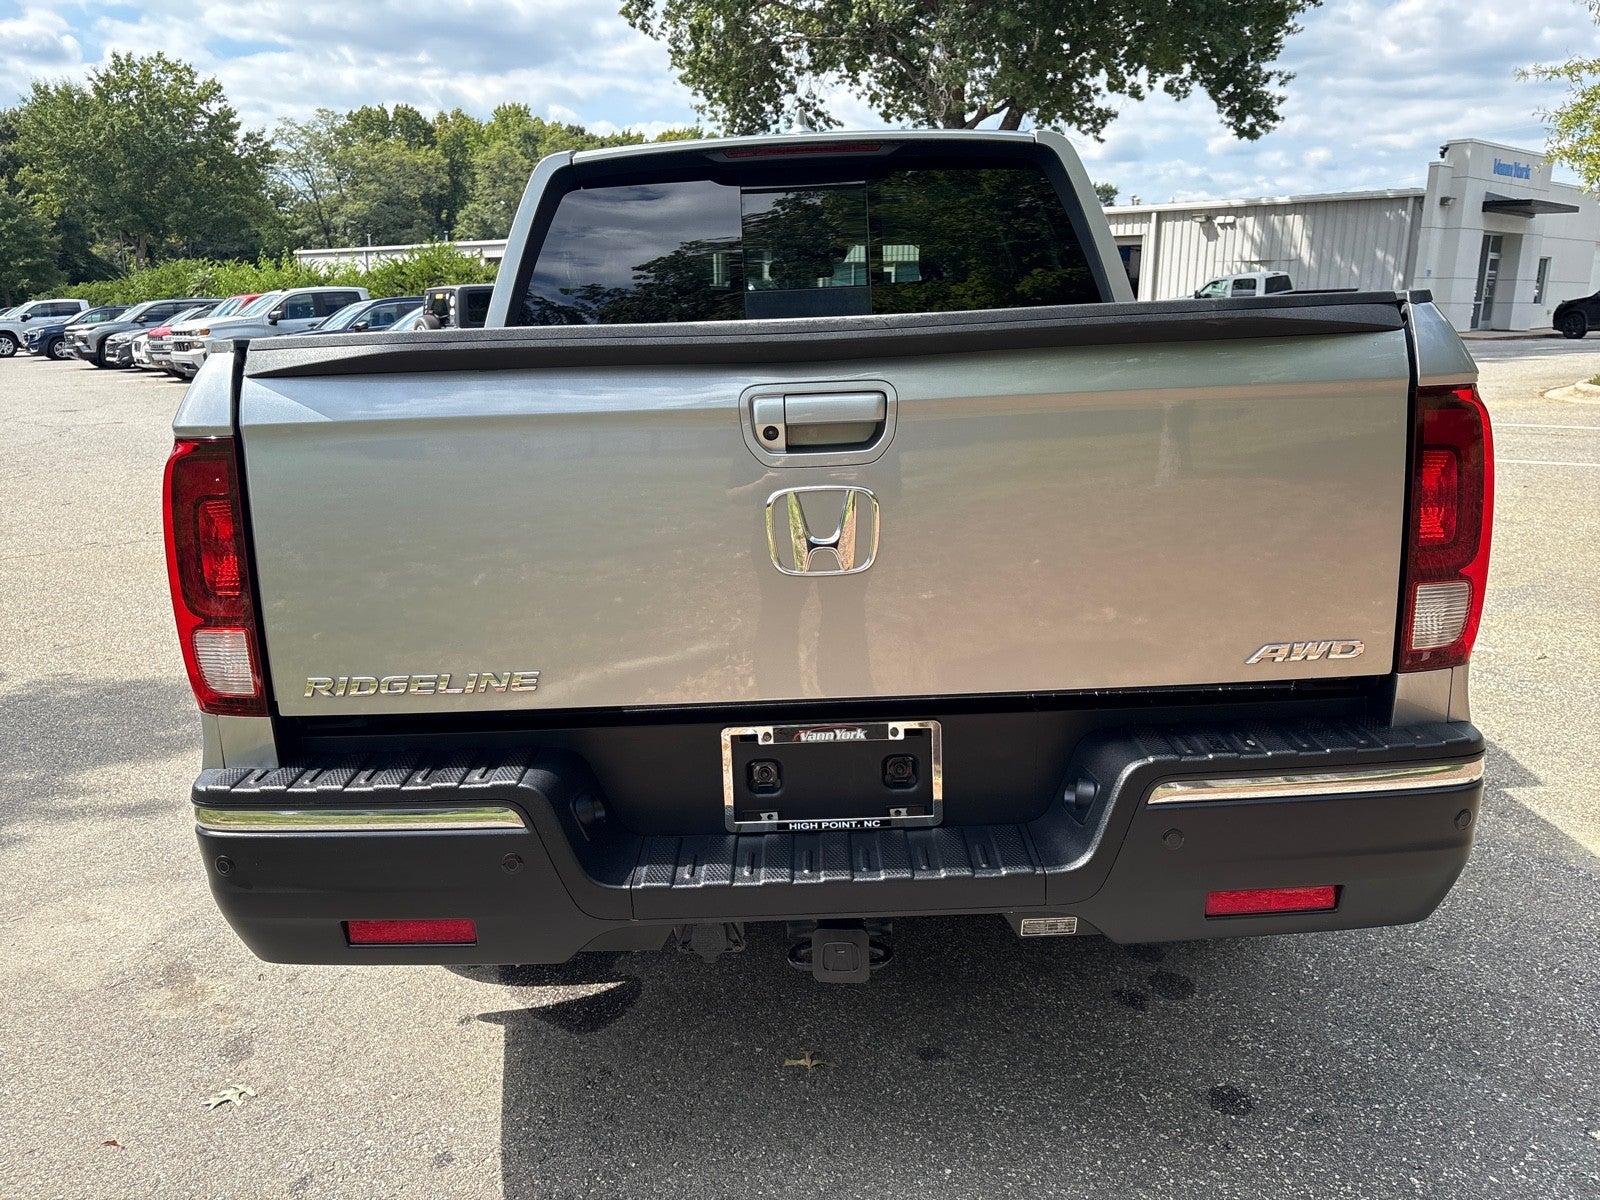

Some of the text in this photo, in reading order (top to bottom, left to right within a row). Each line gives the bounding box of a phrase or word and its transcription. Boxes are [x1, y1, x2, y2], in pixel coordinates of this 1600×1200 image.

[1245, 640, 1365, 664] AWD
[303, 671, 540, 697] RIDGELINE
[789, 822, 818, 830] HIGH
[863, 820, 881, 828] NC
